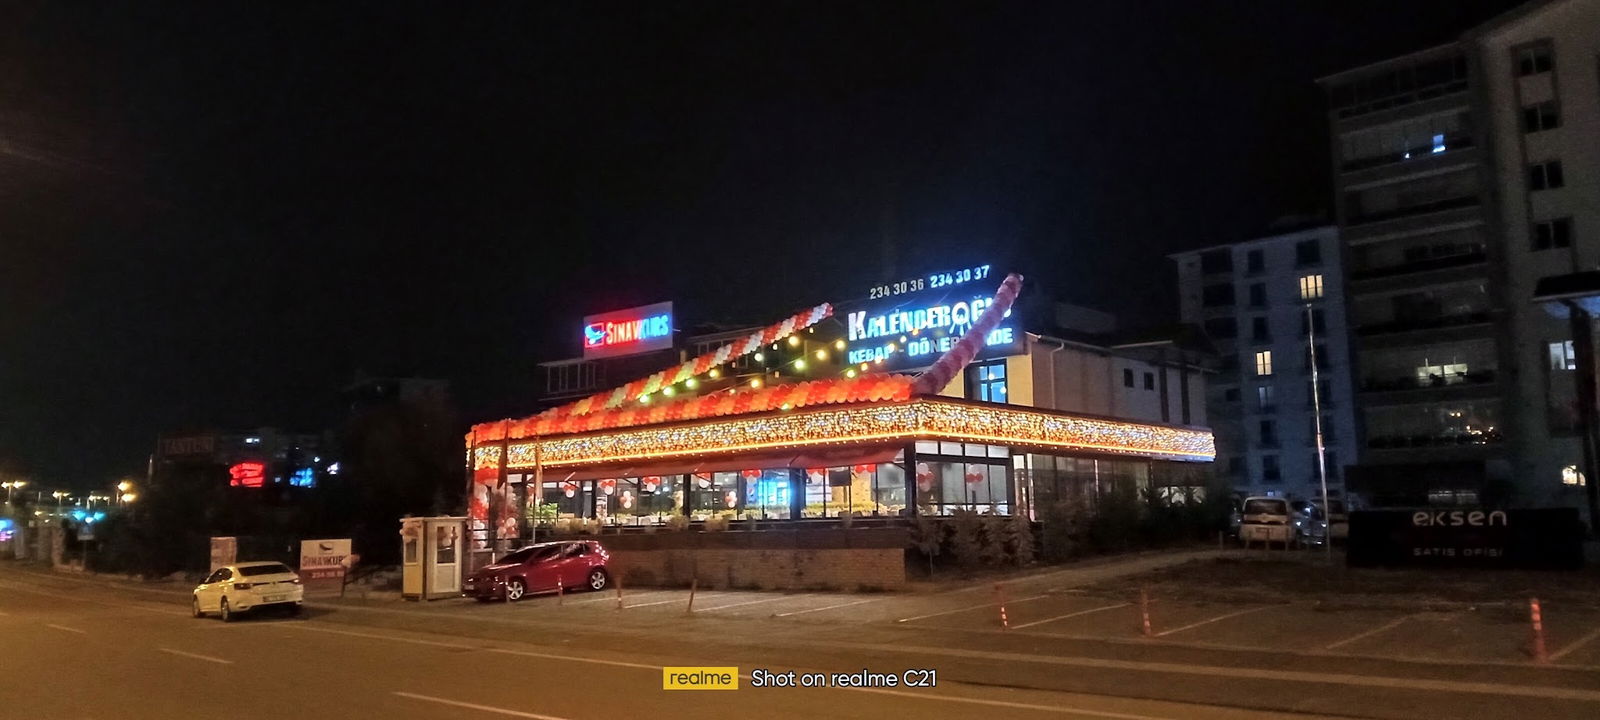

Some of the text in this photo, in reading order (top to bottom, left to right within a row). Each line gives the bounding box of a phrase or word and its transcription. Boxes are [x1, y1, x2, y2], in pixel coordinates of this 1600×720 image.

[870, 264, 990, 300] 234 30 36 234 30 37
[849, 343, 894, 364] KEBAP
[1412, 510, 1508, 527] eksen
